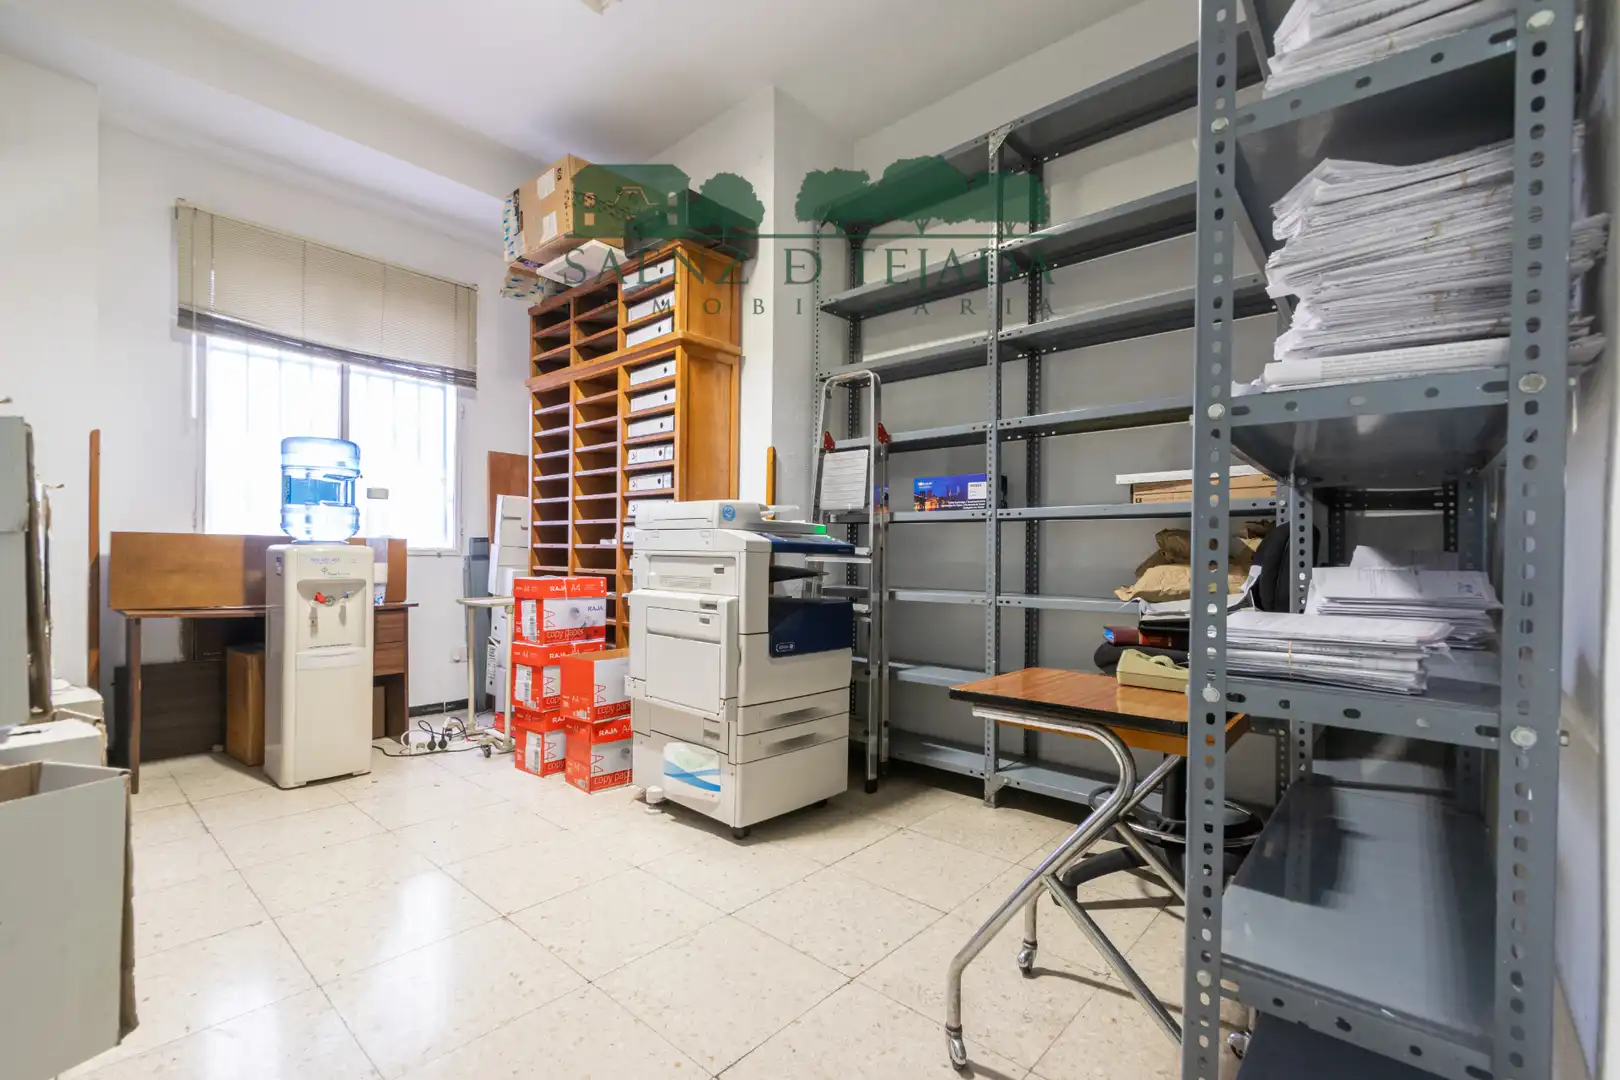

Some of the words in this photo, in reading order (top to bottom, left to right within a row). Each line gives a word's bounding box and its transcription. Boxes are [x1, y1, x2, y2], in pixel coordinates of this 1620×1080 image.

[570, 583, 581, 592] A4
[543, 609, 556, 629] A4
[599, 728, 617, 736] RAJA
[591, 754, 605, 775] A4
